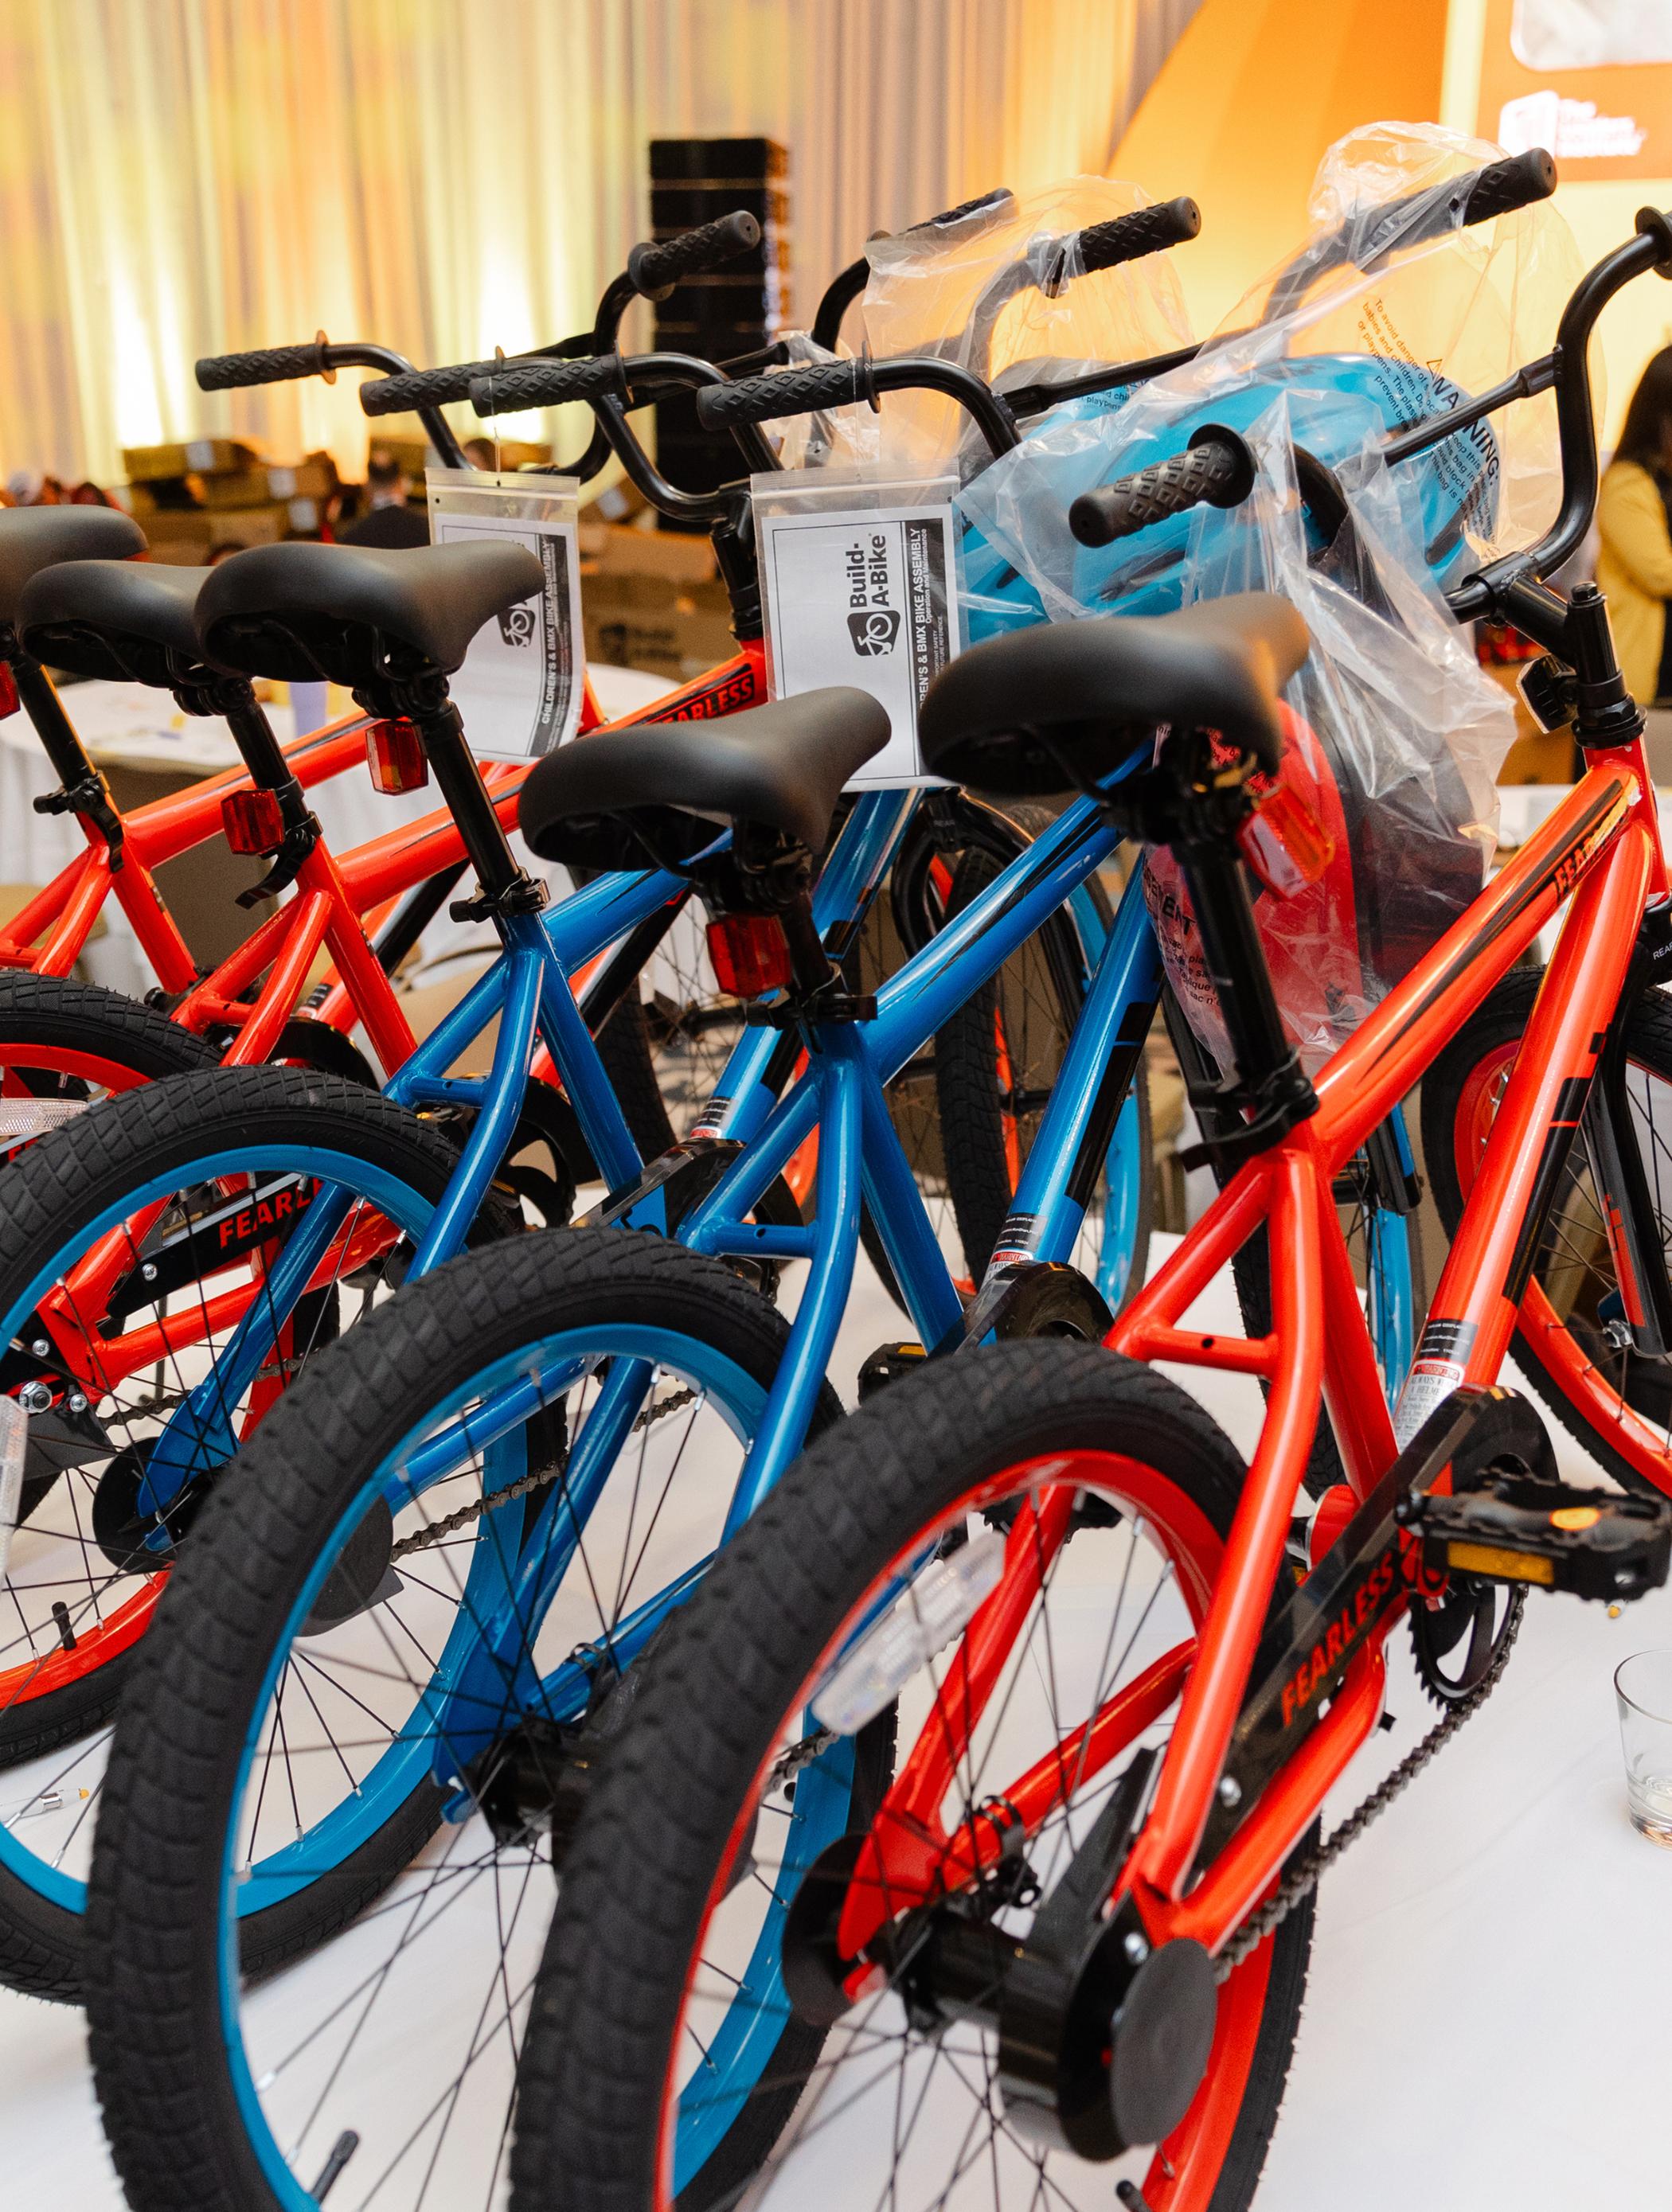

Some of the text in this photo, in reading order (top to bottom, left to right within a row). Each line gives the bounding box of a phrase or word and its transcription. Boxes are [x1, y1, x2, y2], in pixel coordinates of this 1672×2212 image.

[1358, 320, 1366, 332] or
[1362, 333, 1392, 377] playpens.
[1393, 376, 1404, 396] The
[1362, 302, 1381, 335] babies
[1379, 335, 1393, 354] and
[1391, 353, 1416, 395] children.
[1375, 298, 1428, 384] To avoid danger of
[1373, 375, 1400, 413] prevent
[1432, 376, 1499, 486] WANING:
[1445, 464, 1467, 490] block
[1452, 455, 1467, 474] bag
[1466, 451, 1482, 470] this
[1437, 471, 1450, 492] bag
[1448, 486, 1458, 500] is
[541, 540, 553, 600] ASSEMBLY
[909, 528, 924, 593] ASSEMBLY
[920, 529, 930, 574] Maintenance
[846, 543, 868, 608] Build-
[545, 599, 555, 626] BIKE
[913, 595, 926, 624] BIKE
[924, 589, 933, 624] Operation
[546, 626, 557, 650] BMX
[916, 626, 928, 653] BMX
[917, 654, 928, 664] &
[541, 662, 557, 724] CHILDREN'S
[1281, 1551, 1393, 1728] FEARLESS
